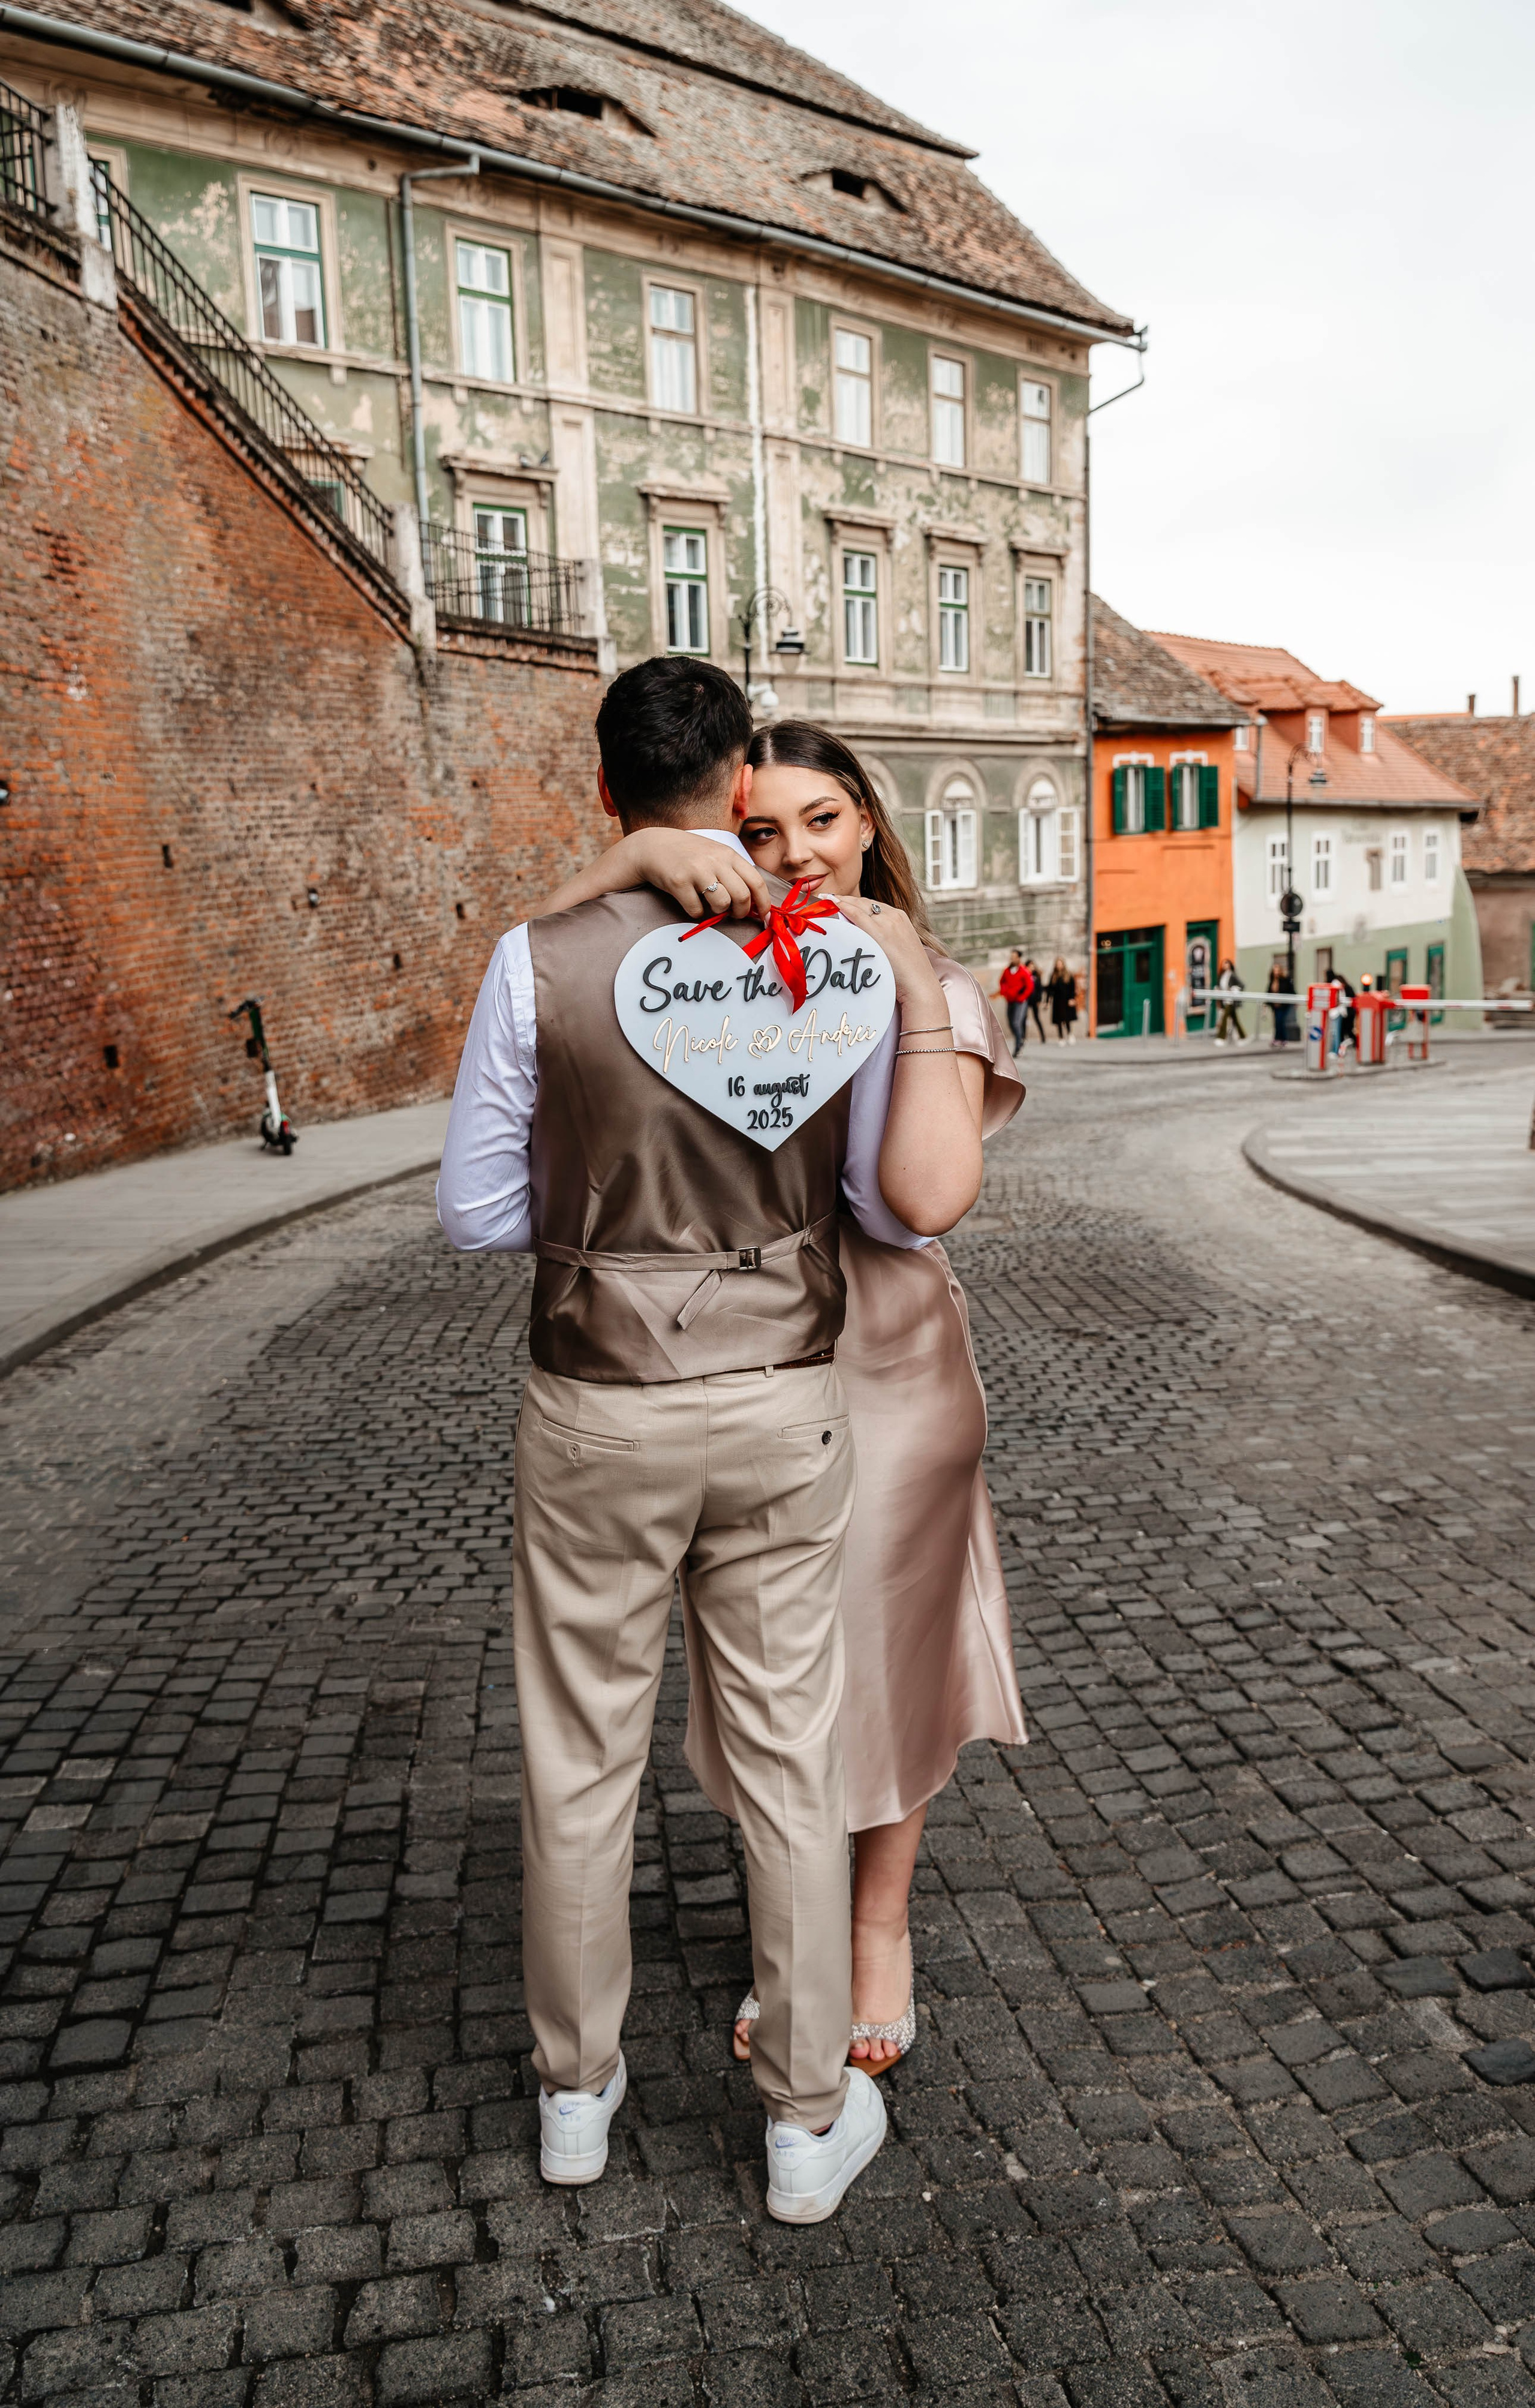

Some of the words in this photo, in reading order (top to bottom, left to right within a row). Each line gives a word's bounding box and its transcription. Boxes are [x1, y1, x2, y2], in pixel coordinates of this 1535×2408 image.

[640, 957, 732, 1012] Save
[736, 965, 782, 1002] the
[799, 946, 881, 1000] Date
[653, 1015, 739, 1073] Nicole
[788, 1009, 877, 1062] Andrei
[728, 1075, 745, 1097] 16
[753, 1073, 811, 1108] august
[747, 1107, 794, 1130] 2025
